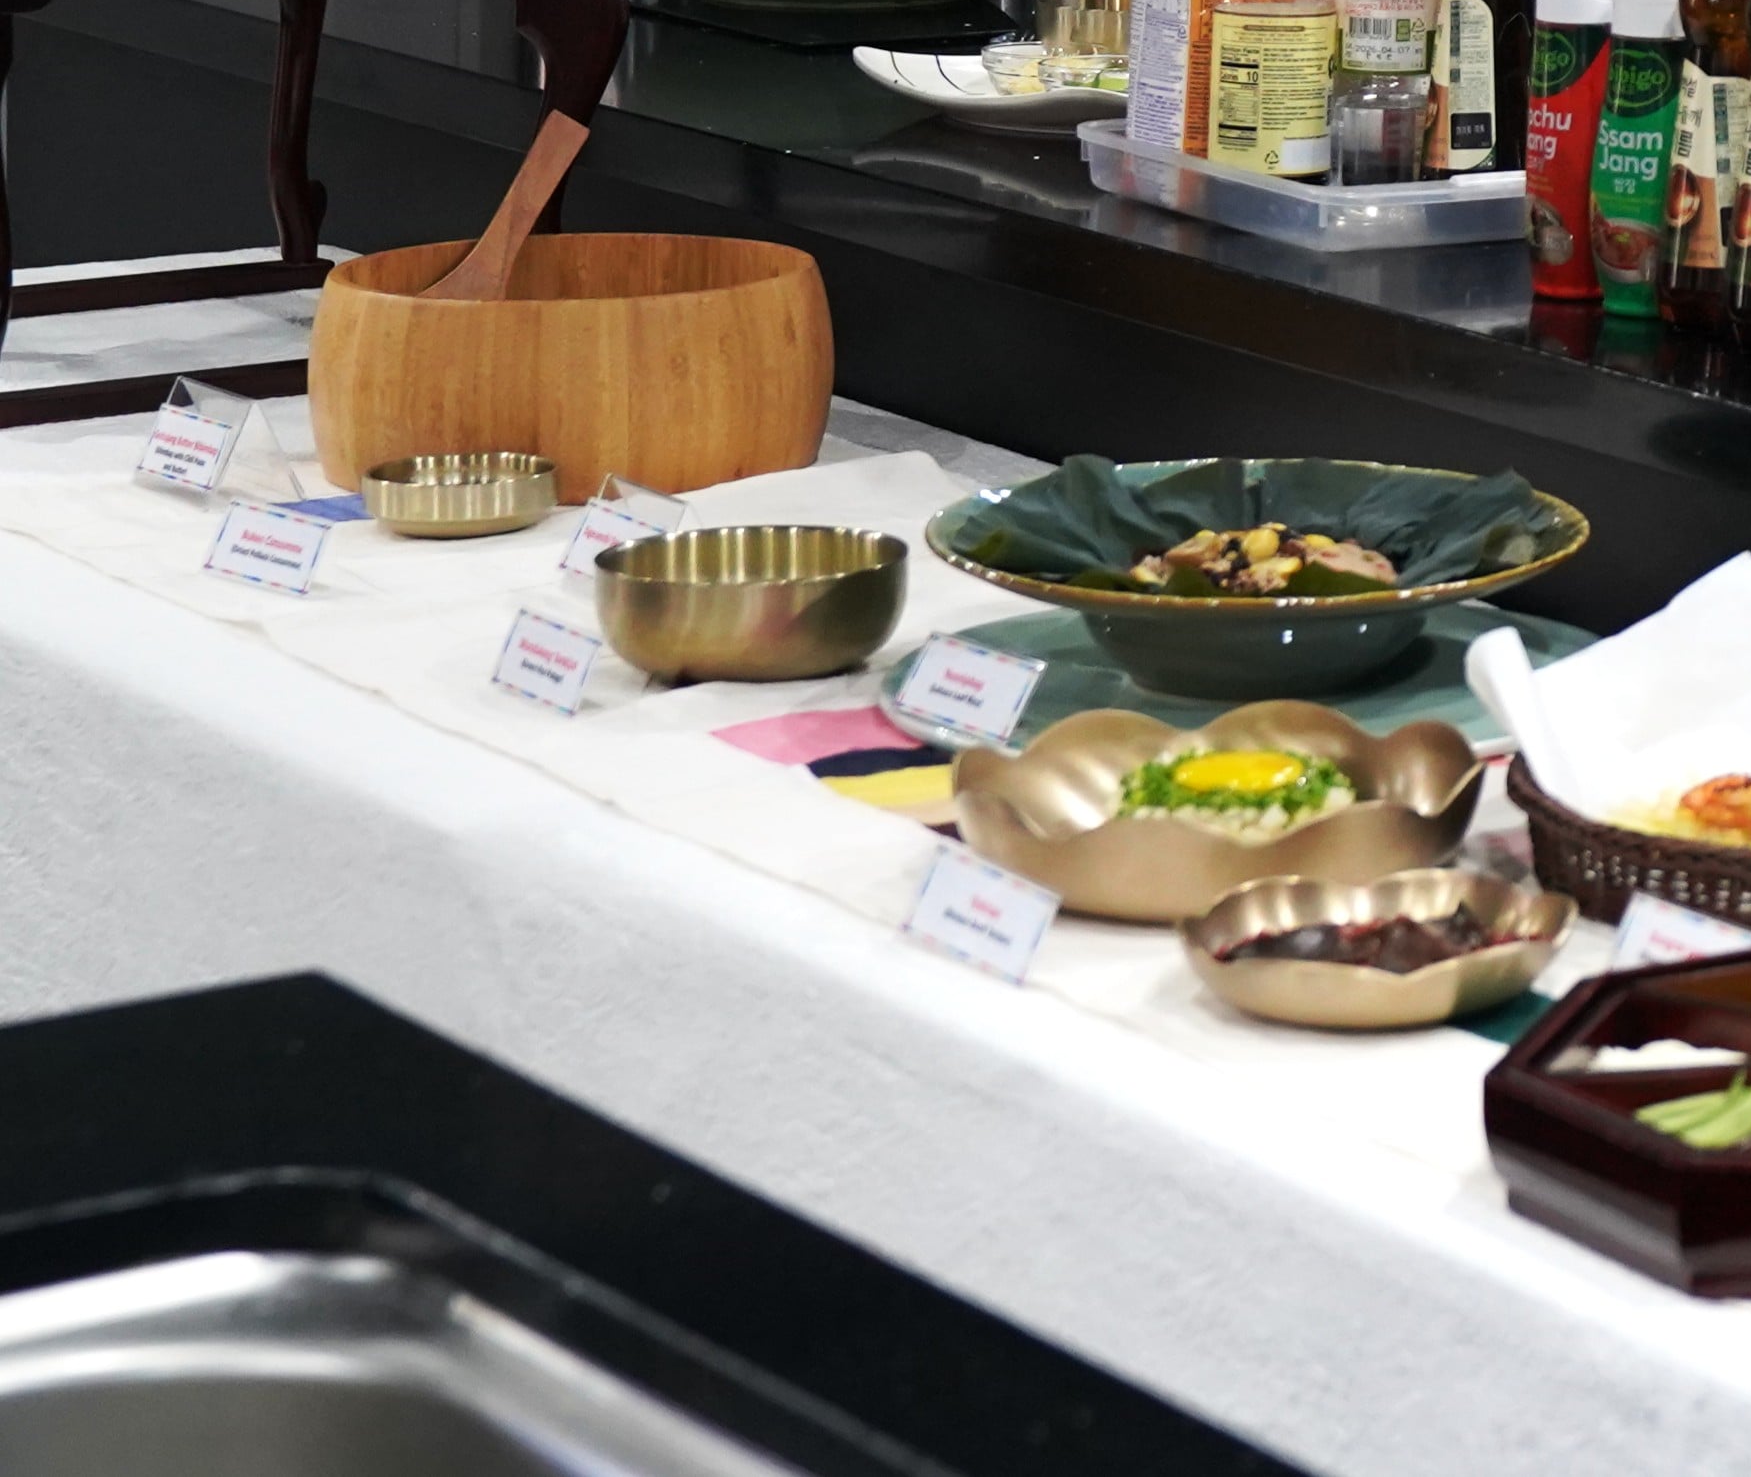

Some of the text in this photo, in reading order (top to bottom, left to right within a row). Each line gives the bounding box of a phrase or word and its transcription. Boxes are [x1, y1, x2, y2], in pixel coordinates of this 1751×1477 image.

[1246, 71, 1259, 84] 10
[1598, 119, 1664, 151] Ssam
[1599, 145, 1659, 182] Jang
